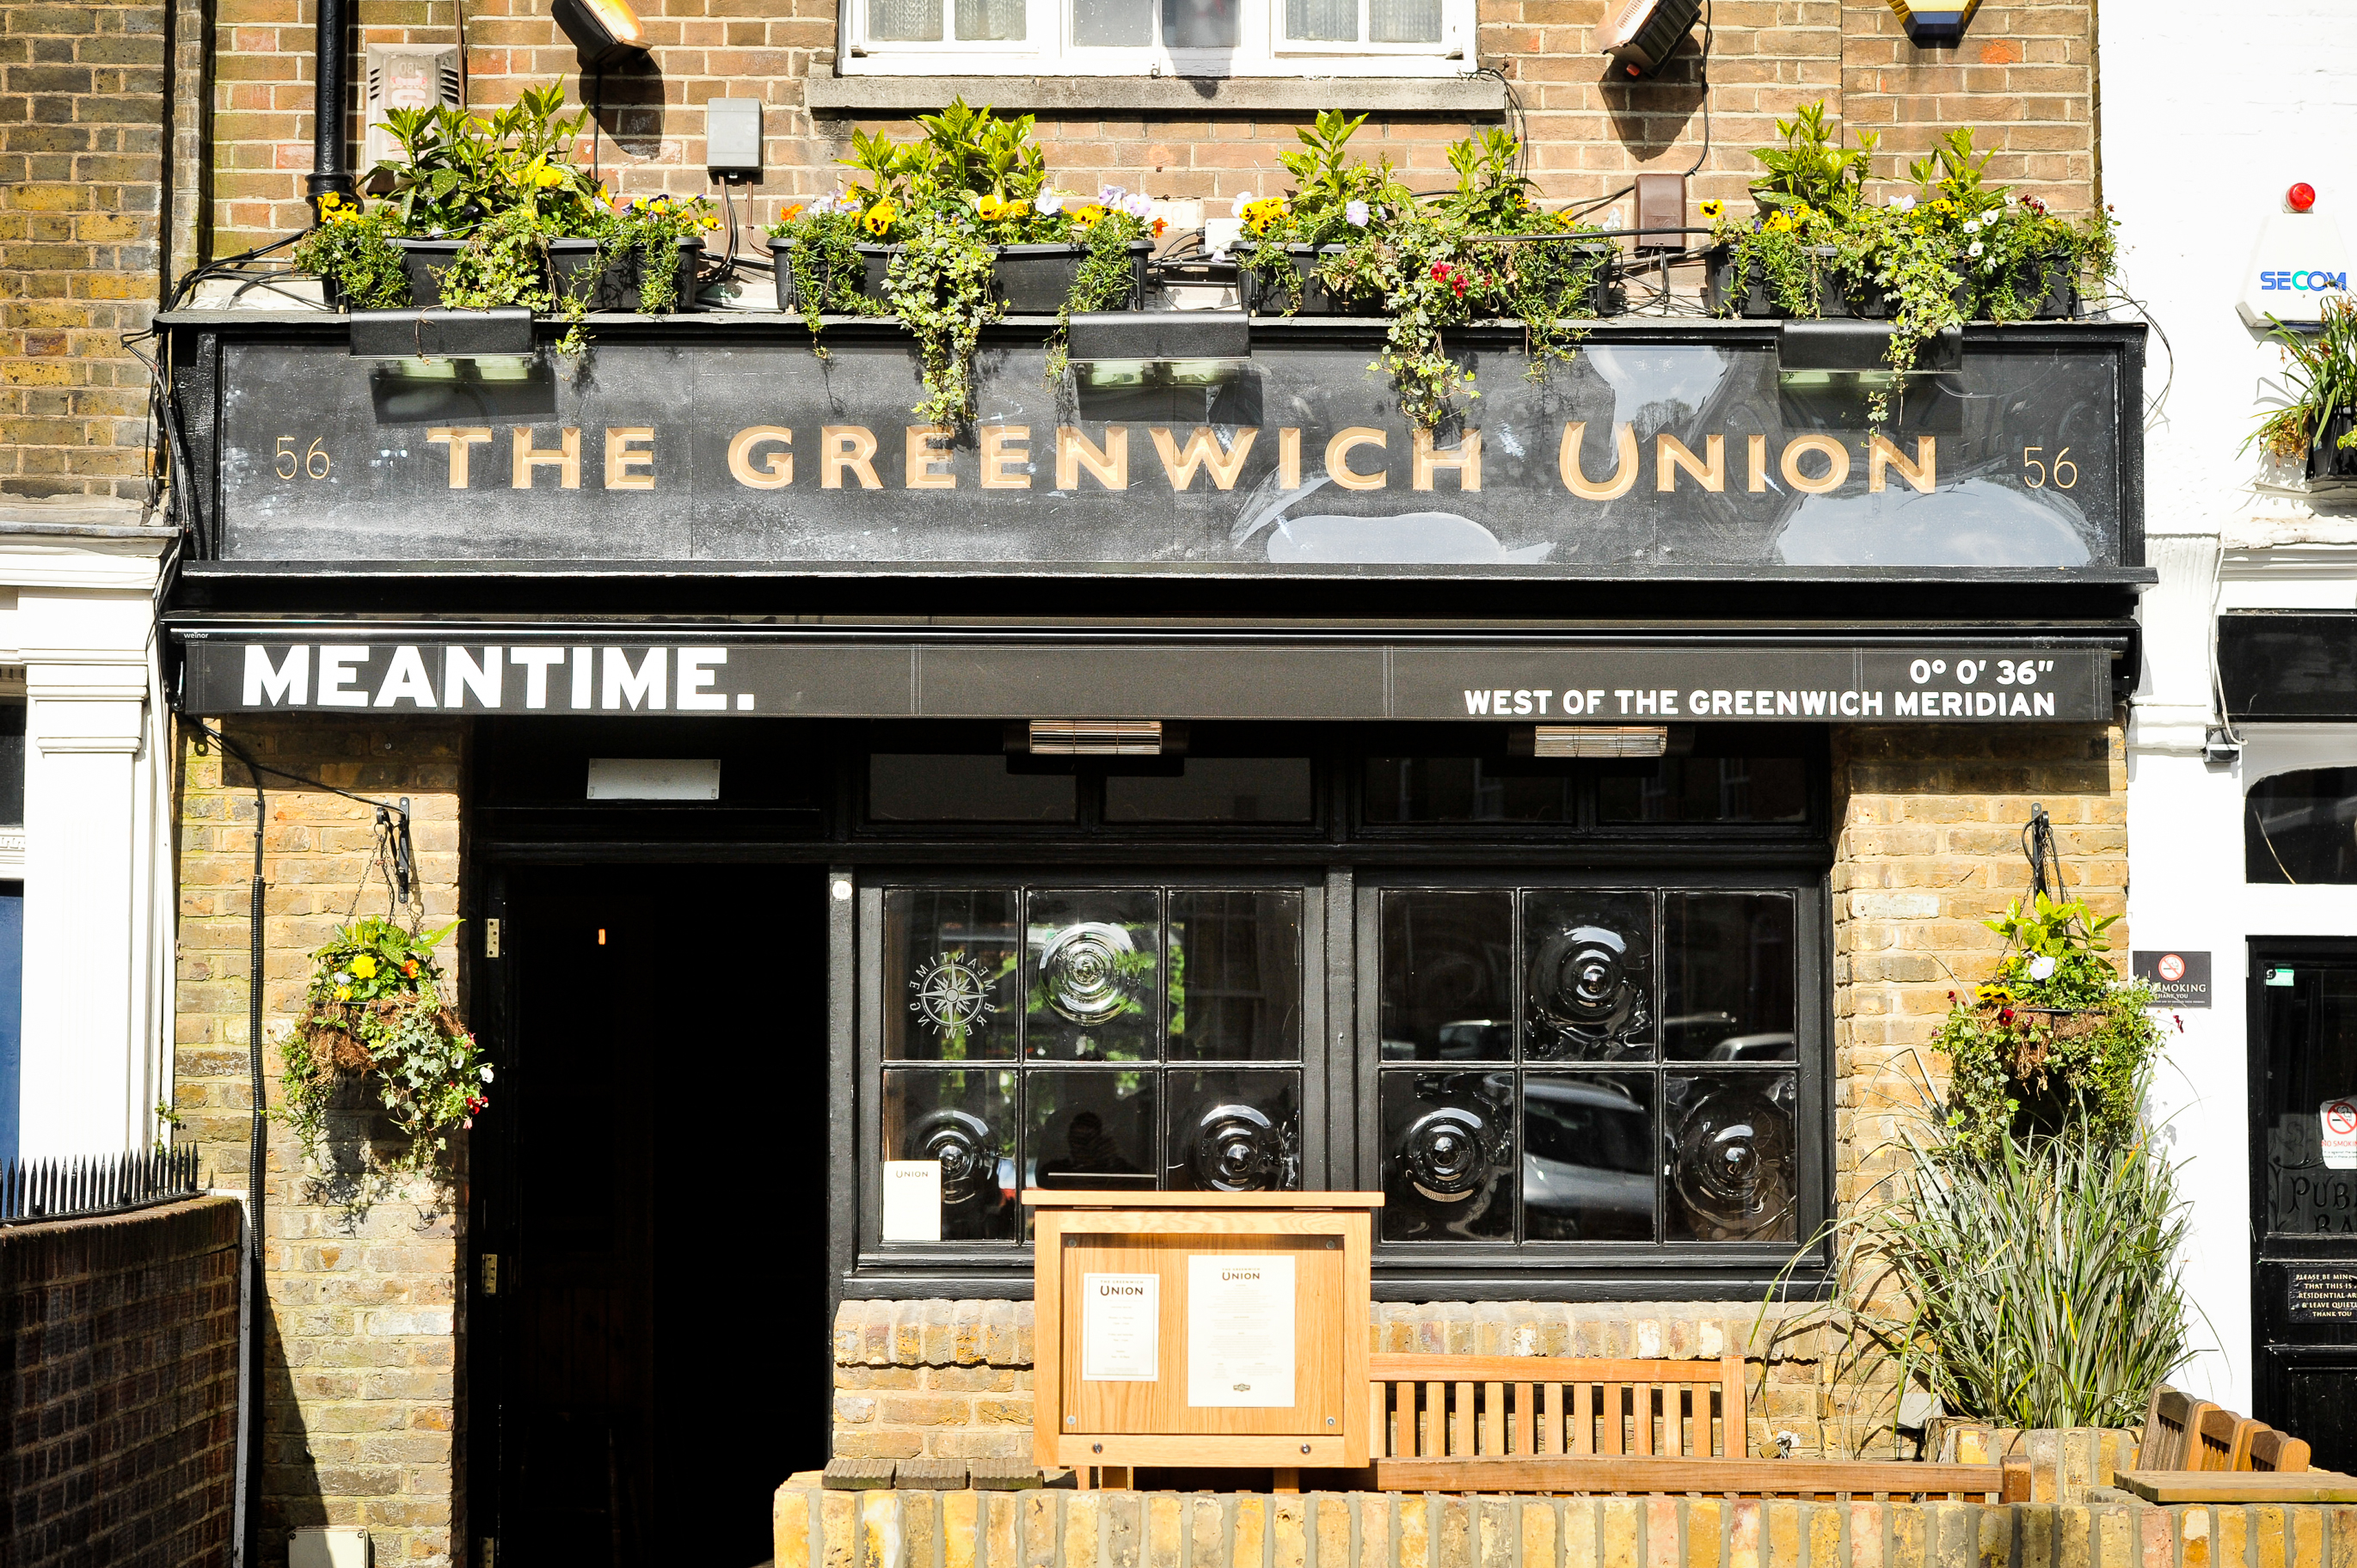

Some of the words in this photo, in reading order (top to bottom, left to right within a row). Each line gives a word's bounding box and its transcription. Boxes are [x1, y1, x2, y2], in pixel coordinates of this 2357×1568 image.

[2261, 271, 2347, 291] SECOM
[274, 435, 330, 481] 56
[427, 427, 655, 490] THE
[727, 425, 1482, 491] GREENWICH
[1559, 420, 1936, 500] UNION
[2023, 446, 2078, 488] 56
[242, 645, 755, 711] MEANTIME.
[1464, 690, 1552, 714] WEST
[1562, 690, 1602, 714] OF
[1614, 690, 1679, 715] THE
[1688, 690, 1883, 716] GREENWICH
[1894, 691, 2055, 717] MERIDIAN
[2287, 1175, 2357, 1214] PUB
[1100, 1285, 1143, 1296] UNION
[1222, 1272, 1260, 1281] UNION
